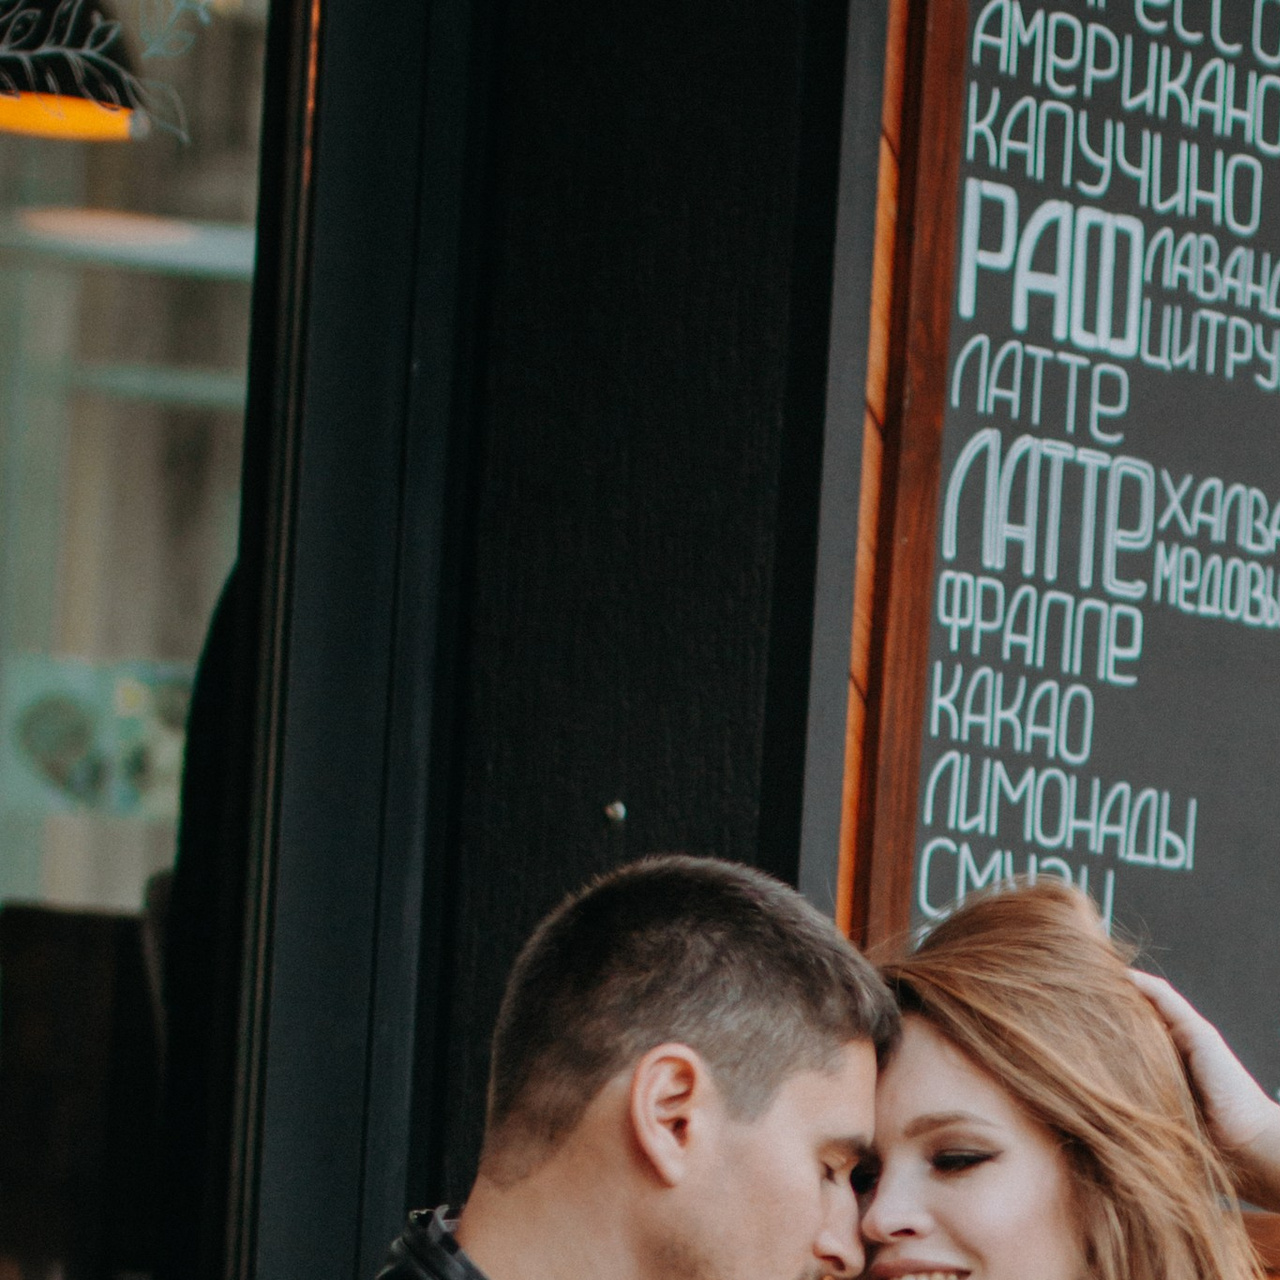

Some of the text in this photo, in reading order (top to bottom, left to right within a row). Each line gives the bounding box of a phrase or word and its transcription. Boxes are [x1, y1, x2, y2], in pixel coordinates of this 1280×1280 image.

[966, 81, 1263, 236] КАПУЧИНО
[958, 177, 1145, 360] РАФ
[929, 659, 1095, 767] КАКАО
[922, 750, 1199, 871] ЛИМОНАДЫ
